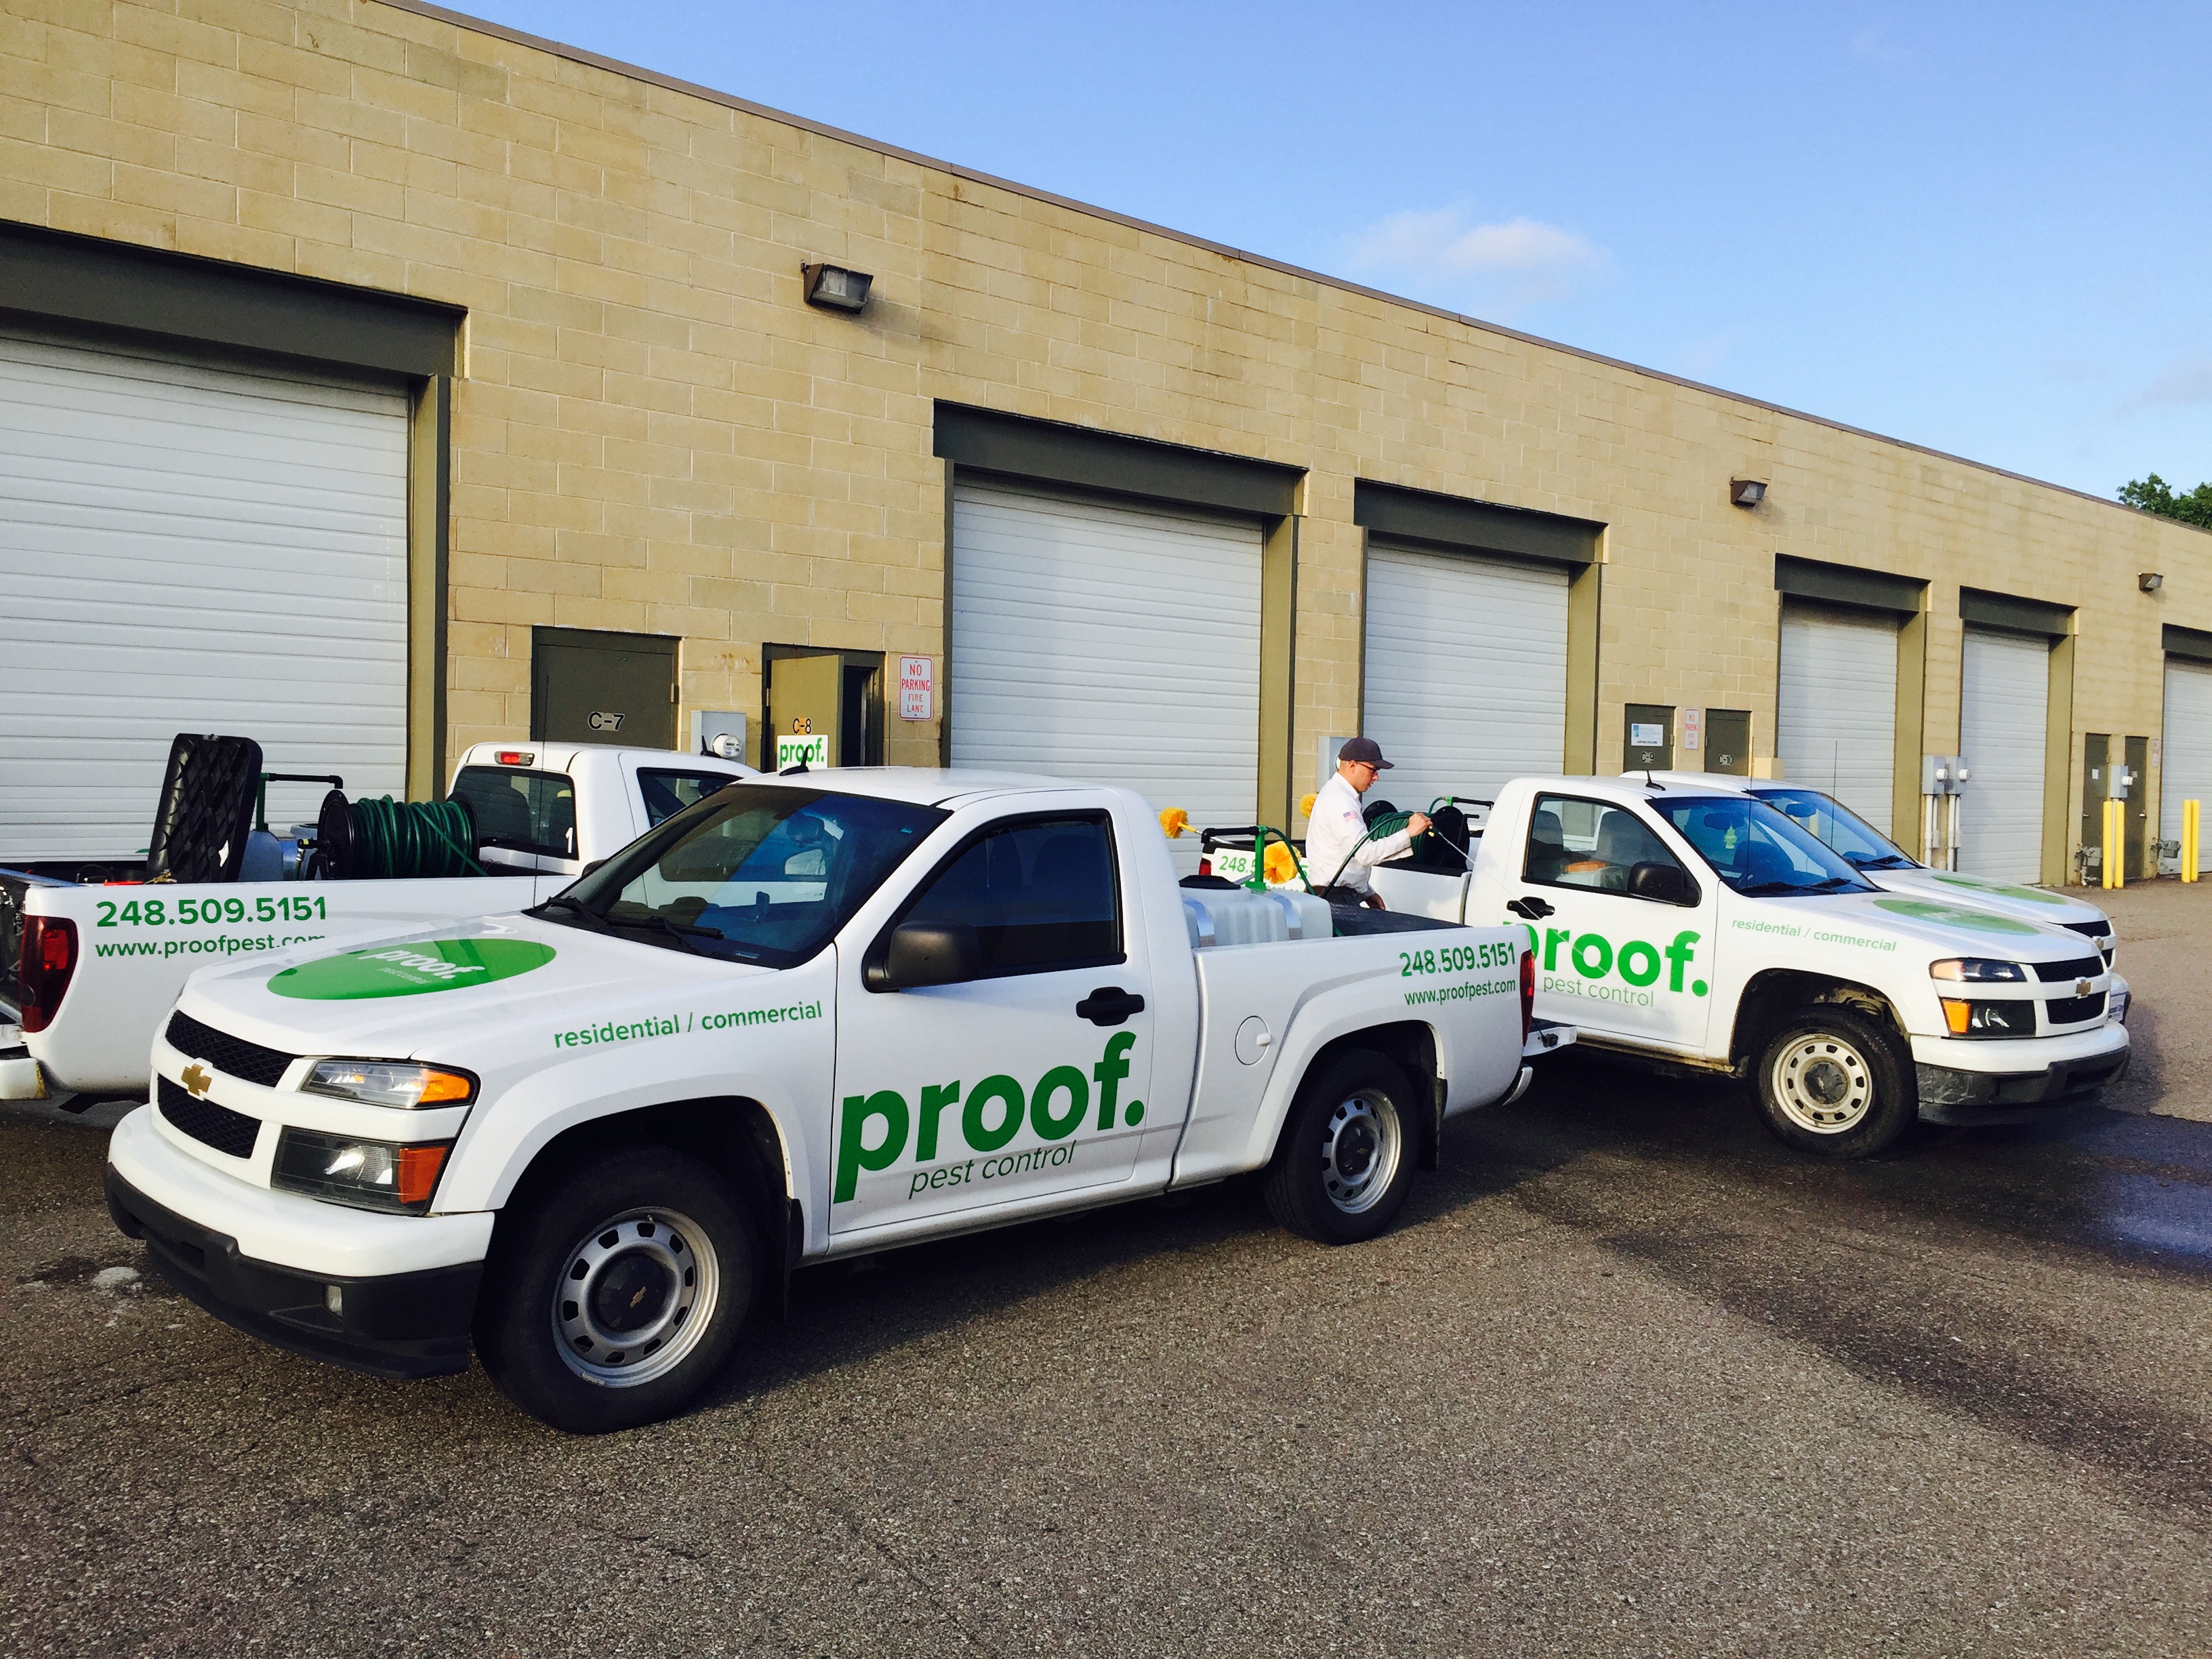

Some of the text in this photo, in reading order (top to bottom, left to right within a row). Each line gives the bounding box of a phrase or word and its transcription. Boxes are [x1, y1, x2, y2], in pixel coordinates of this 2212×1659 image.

[909, 664, 922, 676] NO
[901, 678, 930, 691] PARKING
[908, 693, 923, 702] FIRE
[588, 712, 624, 731] C-7
[907, 704, 924, 713] LANE
[792, 718, 812, 735] C-8
[779, 737, 825, 769] proof.
[1641, 752, 1654, 763] C-9
[1718, 754, 1733, 765] C-10
[96, 896, 326, 927] 248.509.5151
[1732, 920, 1801, 937] residential
[1814, 931, 1897, 951] commercial
[358, 950, 485, 979] proof.
[1399, 942, 1515, 977] 248.509.5151
[1404, 979, 1516, 1005] www.proofpest.com
[1543, 977, 1654, 1007] pest control
[554, 1000, 823, 1048] residential / commercial
[834, 1030, 1145, 1204] proof.
[908, 1139, 1077, 1200] pest control
